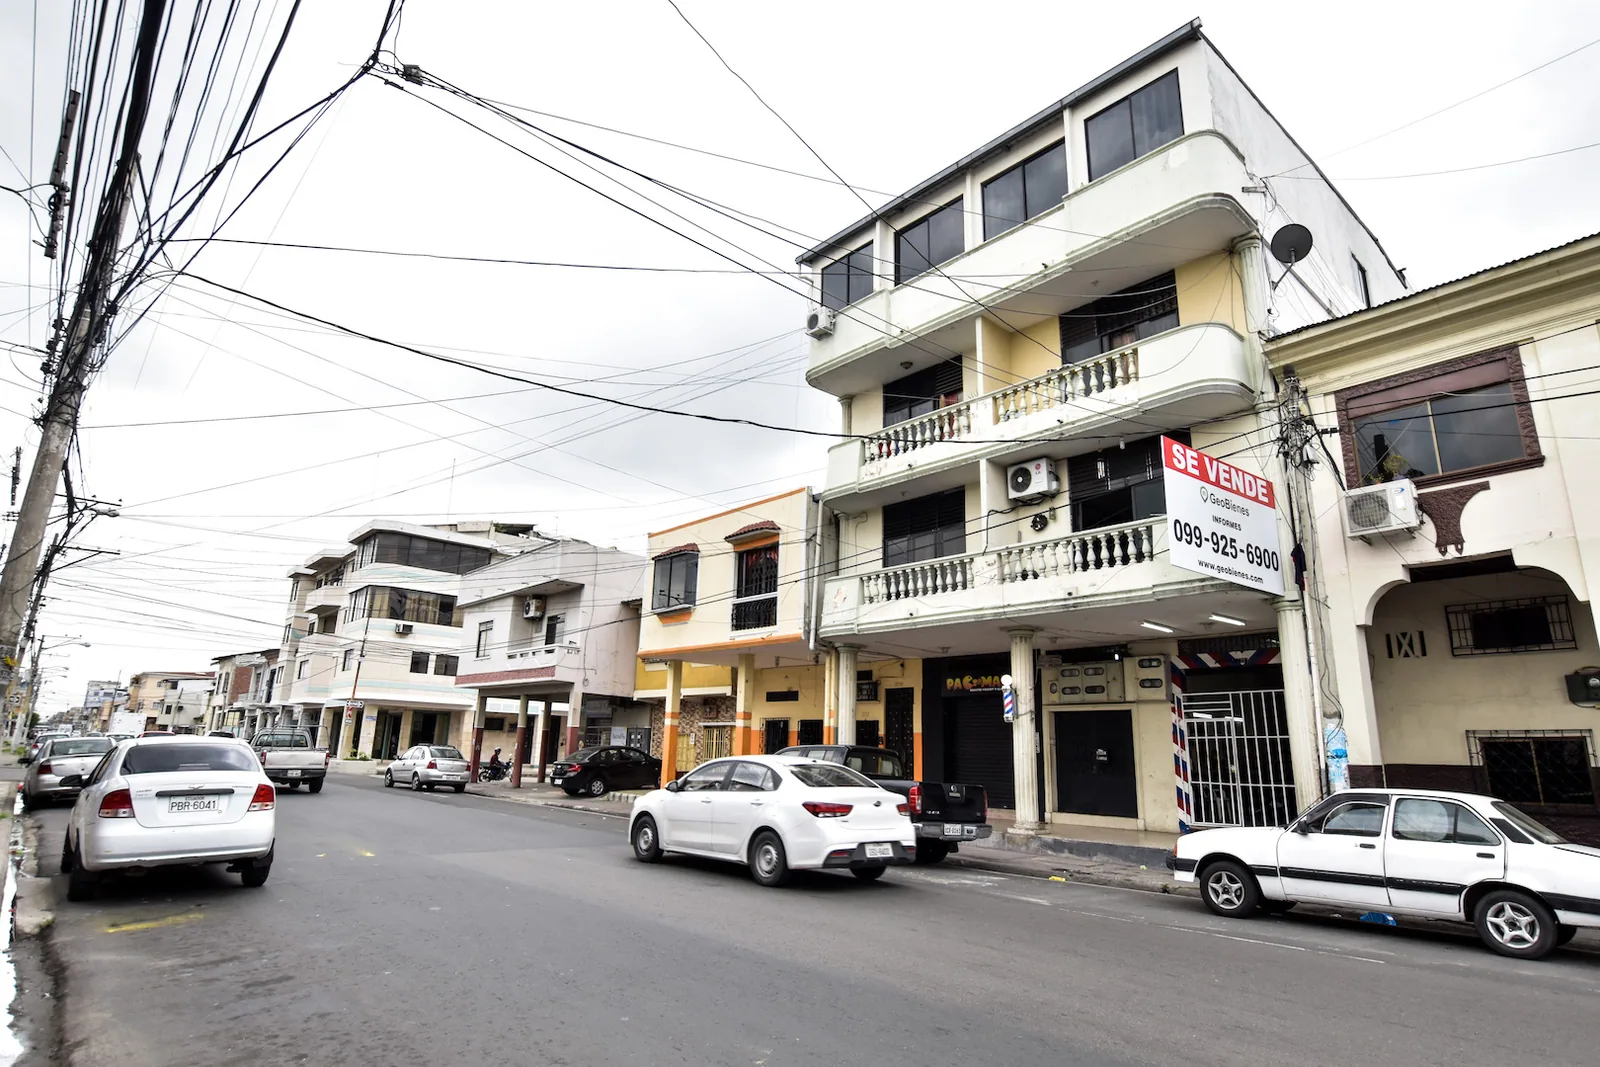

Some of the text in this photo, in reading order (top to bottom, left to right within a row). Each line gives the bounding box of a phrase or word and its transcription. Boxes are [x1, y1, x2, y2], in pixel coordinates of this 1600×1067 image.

[1171, 443, 1269, 503] SE VENDE
[1209, 493, 1250, 517] GeoBienes
[1212, 514, 1242, 532] INFORMES
[1173, 518, 1279, 572] 099-925-6900
[1197, 559, 1264, 584] www.geobienes.com
[980, 675, 1001, 687] MA
[170, 800, 216, 811] PBR-6041
